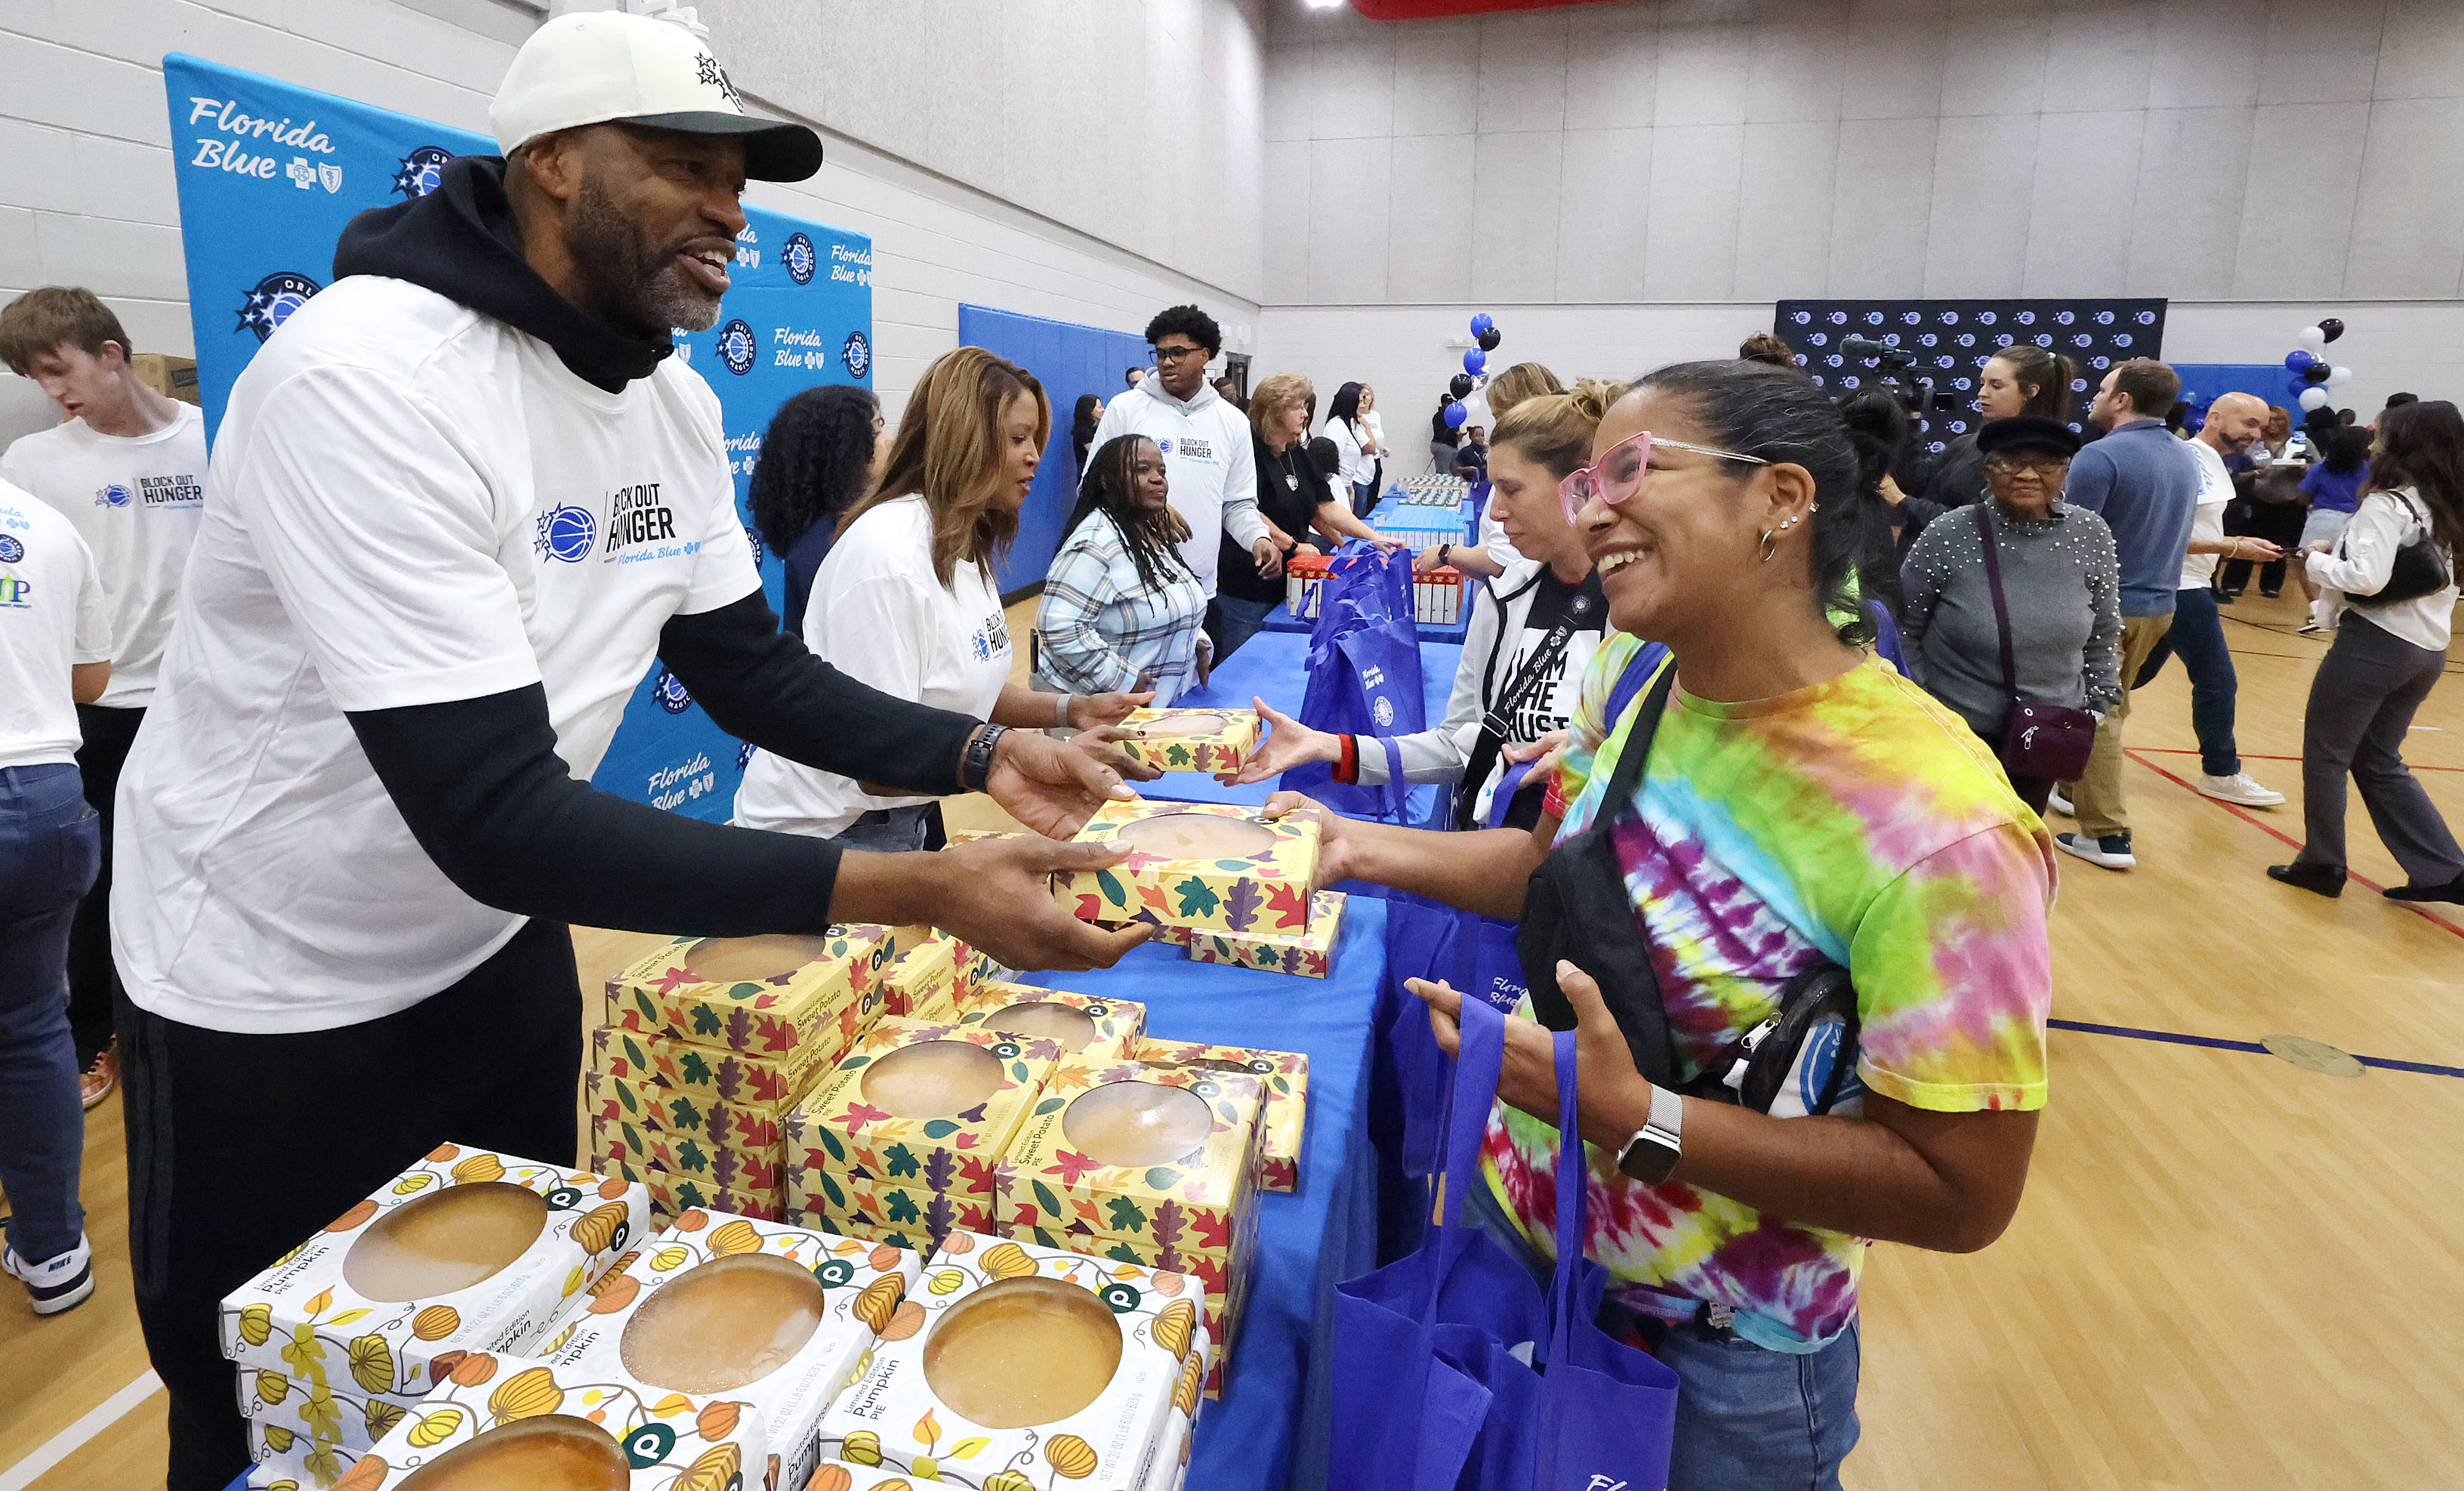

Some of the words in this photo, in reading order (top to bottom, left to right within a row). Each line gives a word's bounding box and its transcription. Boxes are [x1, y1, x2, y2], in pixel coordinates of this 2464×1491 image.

[190, 96, 336, 154] Florida
[191, 138, 277, 179] Blue
[798, 236, 813, 270] ORLANDO
[831, 244, 871, 266] Florida
[792, 270, 810, 282] MAGIC
[831, 265, 855, 282] Blue
[735, 323, 754, 359] ORLANDO
[774, 326, 823, 347] Florida
[774, 347, 803, 368] Blue
[855, 335, 869, 365] ORLANDO
[729, 360, 750, 372] MAGIC
[724, 431, 760, 452] orida
[1180, 437, 1198, 446] BLOCK
[1199, 440, 1210, 448] OUT
[1180, 445, 1212, 459] HUNGER
[140, 476, 174, 489] BLOCK
[175, 474, 194, 486] OUT
[143, 485, 203, 504] HUNGER
[635, 483, 660, 508] OUT
[617, 546, 655, 566] Florida
[657, 545, 682, 560] Blue
[1503, 674, 1534, 715] Florida
[1532, 648, 1553, 674] Blue
[668, 694, 692, 709] MAGIC
[648, 752, 711, 795] Florida
[651, 788, 686, 811] Blue
[797, 1008, 819, 1031] Sweet
[819, 989, 841, 1012] Potato
[787, 1054, 809, 1081] Sweet
[810, 1036, 831, 1059] Potato
[811, 1092, 837, 1115] Sweet
[831, 1070, 856, 1093] Potato
[1019, 1140, 1041, 1165] Sweet
[1033, 1114, 1055, 1140] Potato
[1032, 1156, 1043, 1166] PIE
[48, 1255, 72, 1273] NIKE
[253, 1265, 289, 1290] Limited
[288, 1243, 319, 1266] Edition
[261, 1246, 330, 1292] Pumpkin
[274, 1283, 295, 1295] PIE
[504, 1309, 530, 1333] Edition
[560, 1328, 588, 1353] Edition
[843, 1383, 868, 1414] Limited
[863, 1357, 887, 1384] Edition
[853, 1360, 900, 1418] Pumpkin
[869, 1405, 887, 1421] PIE
[1125, 1397, 1140, 1410] 623
[1121, 1408, 1136, 1421] OZ)
[787, 1428, 810, 1467] Limited
[810, 1401, 830, 1432] Edition
[1117, 1424, 1130, 1434] LB
[1107, 1449, 1121, 1460] 22
[1112, 1440, 1124, 1450] OZ
[1104, 1458, 1117, 1471] WT
[789, 1471, 801, 1491] PIE
[1099, 1469, 1114, 1483] NET
